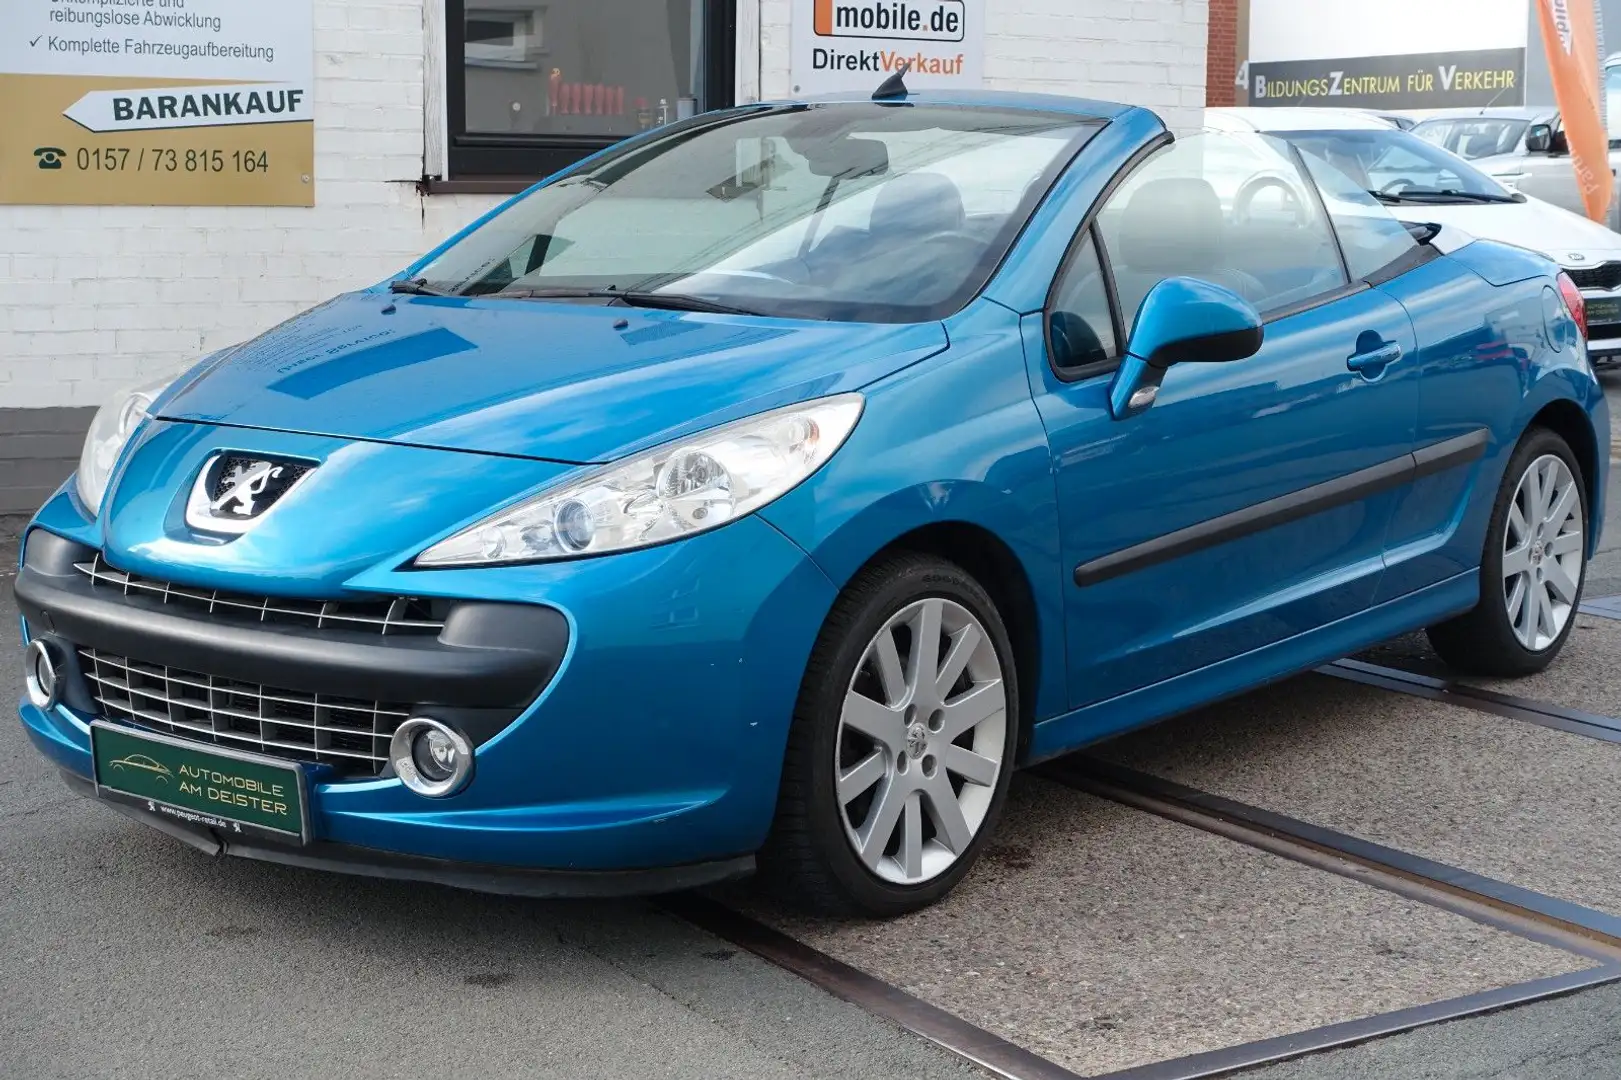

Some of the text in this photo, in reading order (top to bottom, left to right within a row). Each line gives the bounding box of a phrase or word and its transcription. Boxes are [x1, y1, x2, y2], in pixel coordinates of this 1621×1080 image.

[50, 8, 222, 32] reibungslose Abwicklung
[836, 2, 959, 33] mobile.de
[48, 36, 274, 62] Komplette Fahrzeugaufbereitung
[812, 48, 964, 75] DirektVerkauf
[1255, 64, 1515, 98] BILDUNGSZENTRUM FÜR VERKEHR
[113, 89, 304, 121] BARANKAUF
[77, 148, 130, 171] 0157
[152, 149, 178, 171] 73
[185, 149, 224, 172] 815
[232, 150, 269, 173] 164
[179, 764, 284, 798] AUTOMOBILE
[179, 781, 287, 815] AM DEISTER
